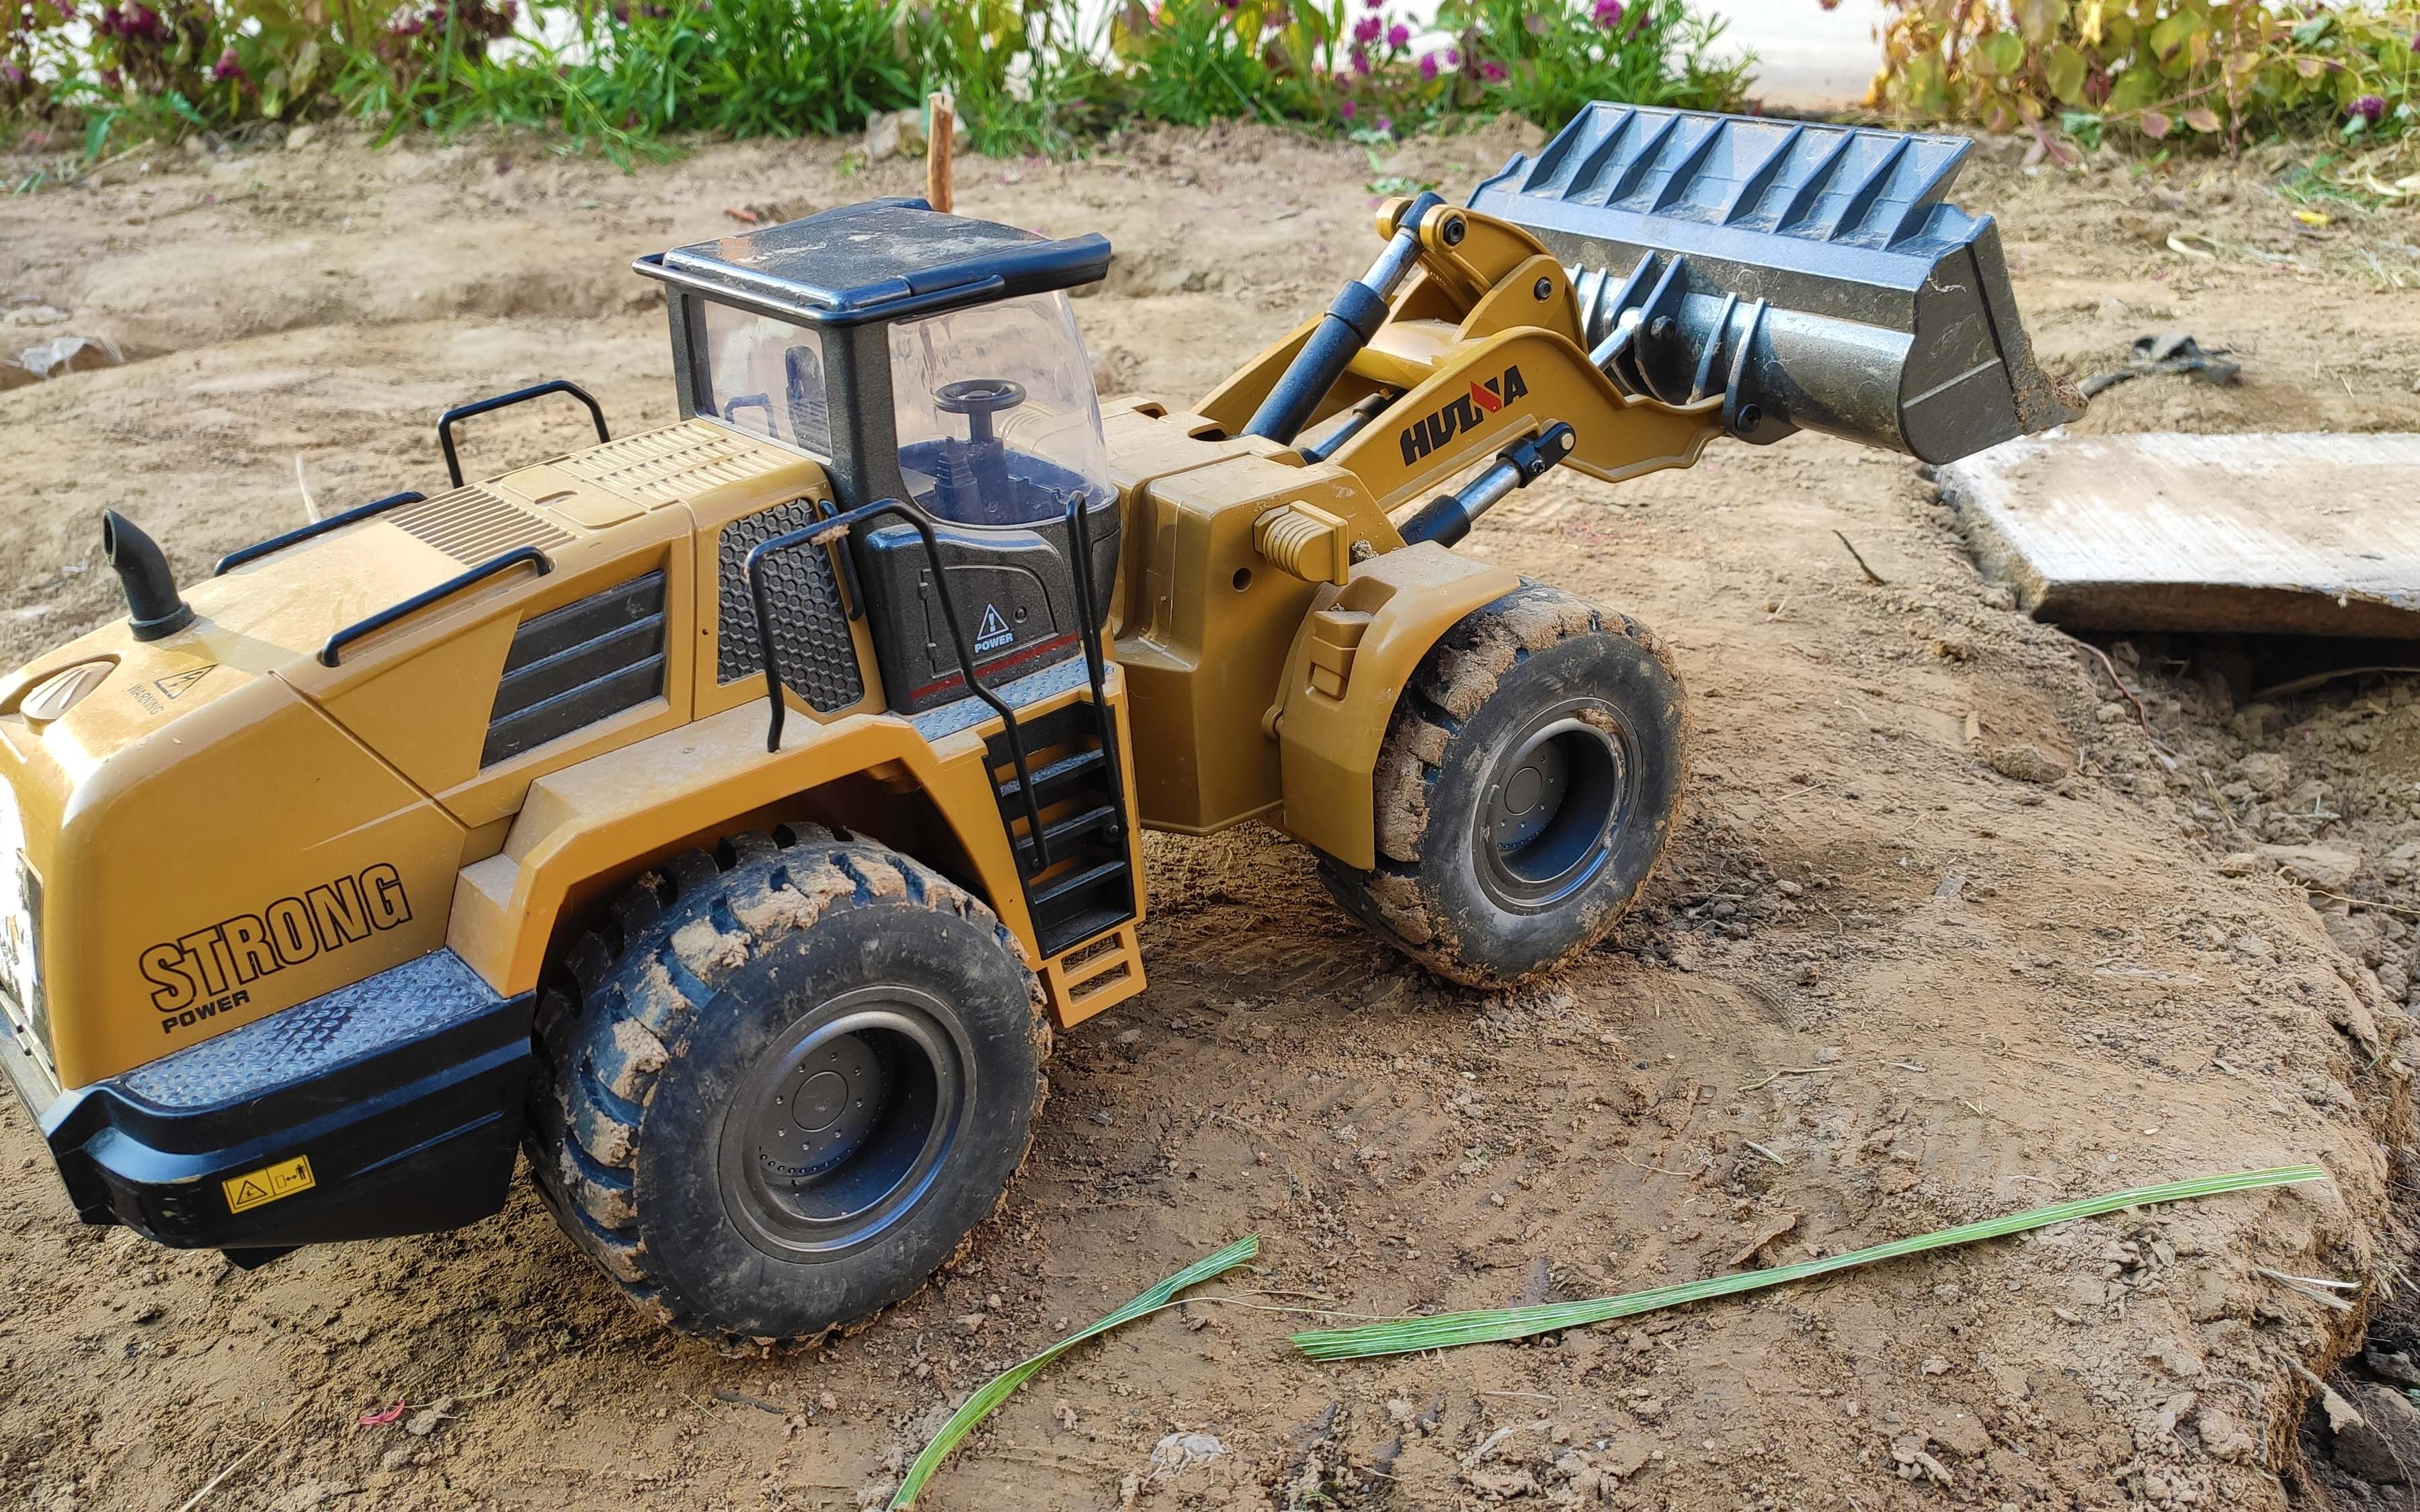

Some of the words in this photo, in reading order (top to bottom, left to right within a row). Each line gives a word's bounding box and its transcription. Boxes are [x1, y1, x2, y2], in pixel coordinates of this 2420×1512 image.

[1400, 365, 1529, 466] HUINA
[974, 632, 1014, 654] POWER
[127, 683, 164, 715] WARNING
[139, 863, 413, 1013] STRONG
[161, 989, 251, 1034] POWER
